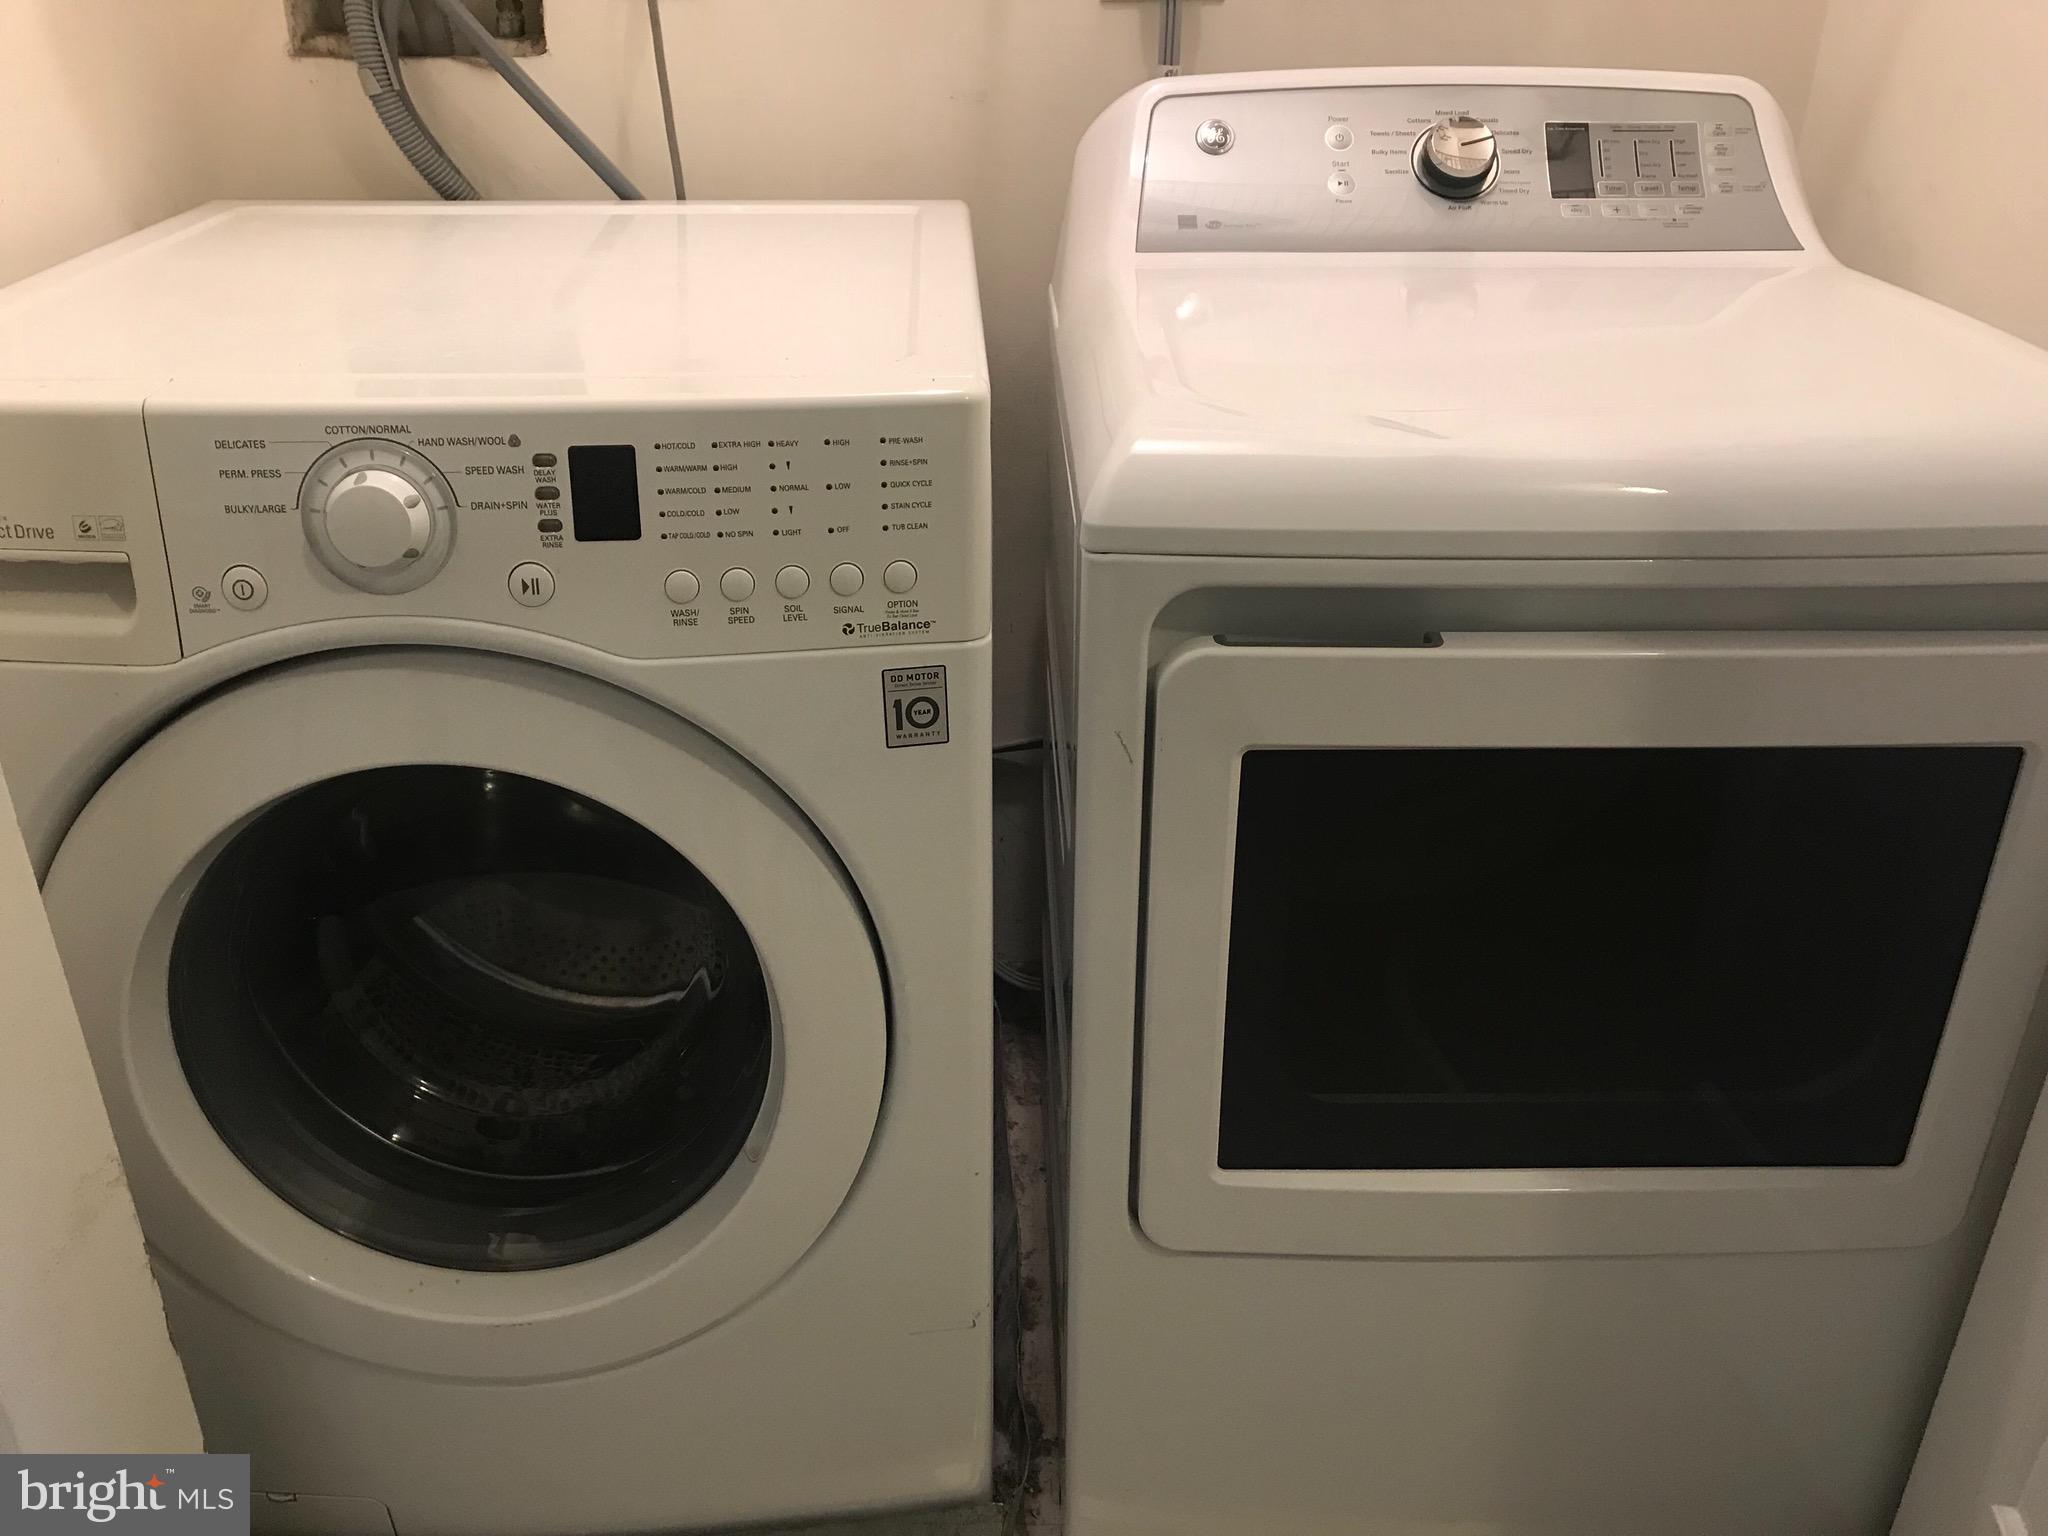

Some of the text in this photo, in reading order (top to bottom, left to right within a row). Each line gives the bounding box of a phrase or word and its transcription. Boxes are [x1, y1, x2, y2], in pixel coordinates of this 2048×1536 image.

[324, 424, 412, 436] COTTON/NORMAL
[213, 439, 267, 450] DELICATES
[417, 434, 507, 450] HAND WASH/WOOL
[718, 440, 762, 449] EXTRA HIGH
[775, 439, 800, 448] HEAVY
[888, 436, 924, 445] PRE-WASH
[661, 441, 696, 450] HOT/COLD
[889, 458, 929, 467] RINSE+SPIN
[464, 464, 525, 475] SPEED WASH
[663, 464, 708, 473] WARM/WARM
[719, 463, 739, 472] HIGH
[218, 468, 282, 480] PERM. PRESS
[533, 469, 556, 477] DELAY
[534, 476, 557, 484] WASH
[889, 479, 933, 489] QUICK CYCLE
[721, 485, 752, 494] MEDIUM
[778, 484, 810, 493] NORMAL
[834, 482, 851, 491] LOW
[664, 487, 707, 496] WARM/COLD
[223, 503, 287, 515] BULKY/LARGE
[470, 501, 529, 512] DRAIN+SPIN
[535, 501, 561, 510] WATER
[890, 501, 933, 511] STAIN CYCLE
[539, 509, 559, 517] PLUS
[722, 507, 741, 516] LOW
[836, 526, 850, 534] OFF
[891, 522, 929, 532] TUB CLEAN
[14, 524, 55, 540] Drive
[668, 531, 680, 540] TAP
[724, 530, 755, 540] NO SPIN
[781, 529, 803, 537] LIGHT
[540, 533, 565, 541] EXTRA
[542, 541, 564, 549] RINSE
[887, 599, 919, 609] OPTION
[670, 609, 701, 618] WASH/
[729, 606, 751, 617] SPIN
[783, 604, 804, 614] SOIL
[833, 606, 865, 615] SIGNAL
[672, 617, 699, 628] RINSE
[727, 615, 756, 625] SPEED
[782, 613, 809, 623] LEVEL
[890, 671, 940, 683] DD MOTOR
[892, 695, 941, 731] 10
[913, 708, 932, 716] YEAR
[895, 730, 941, 740] WARRANTY
